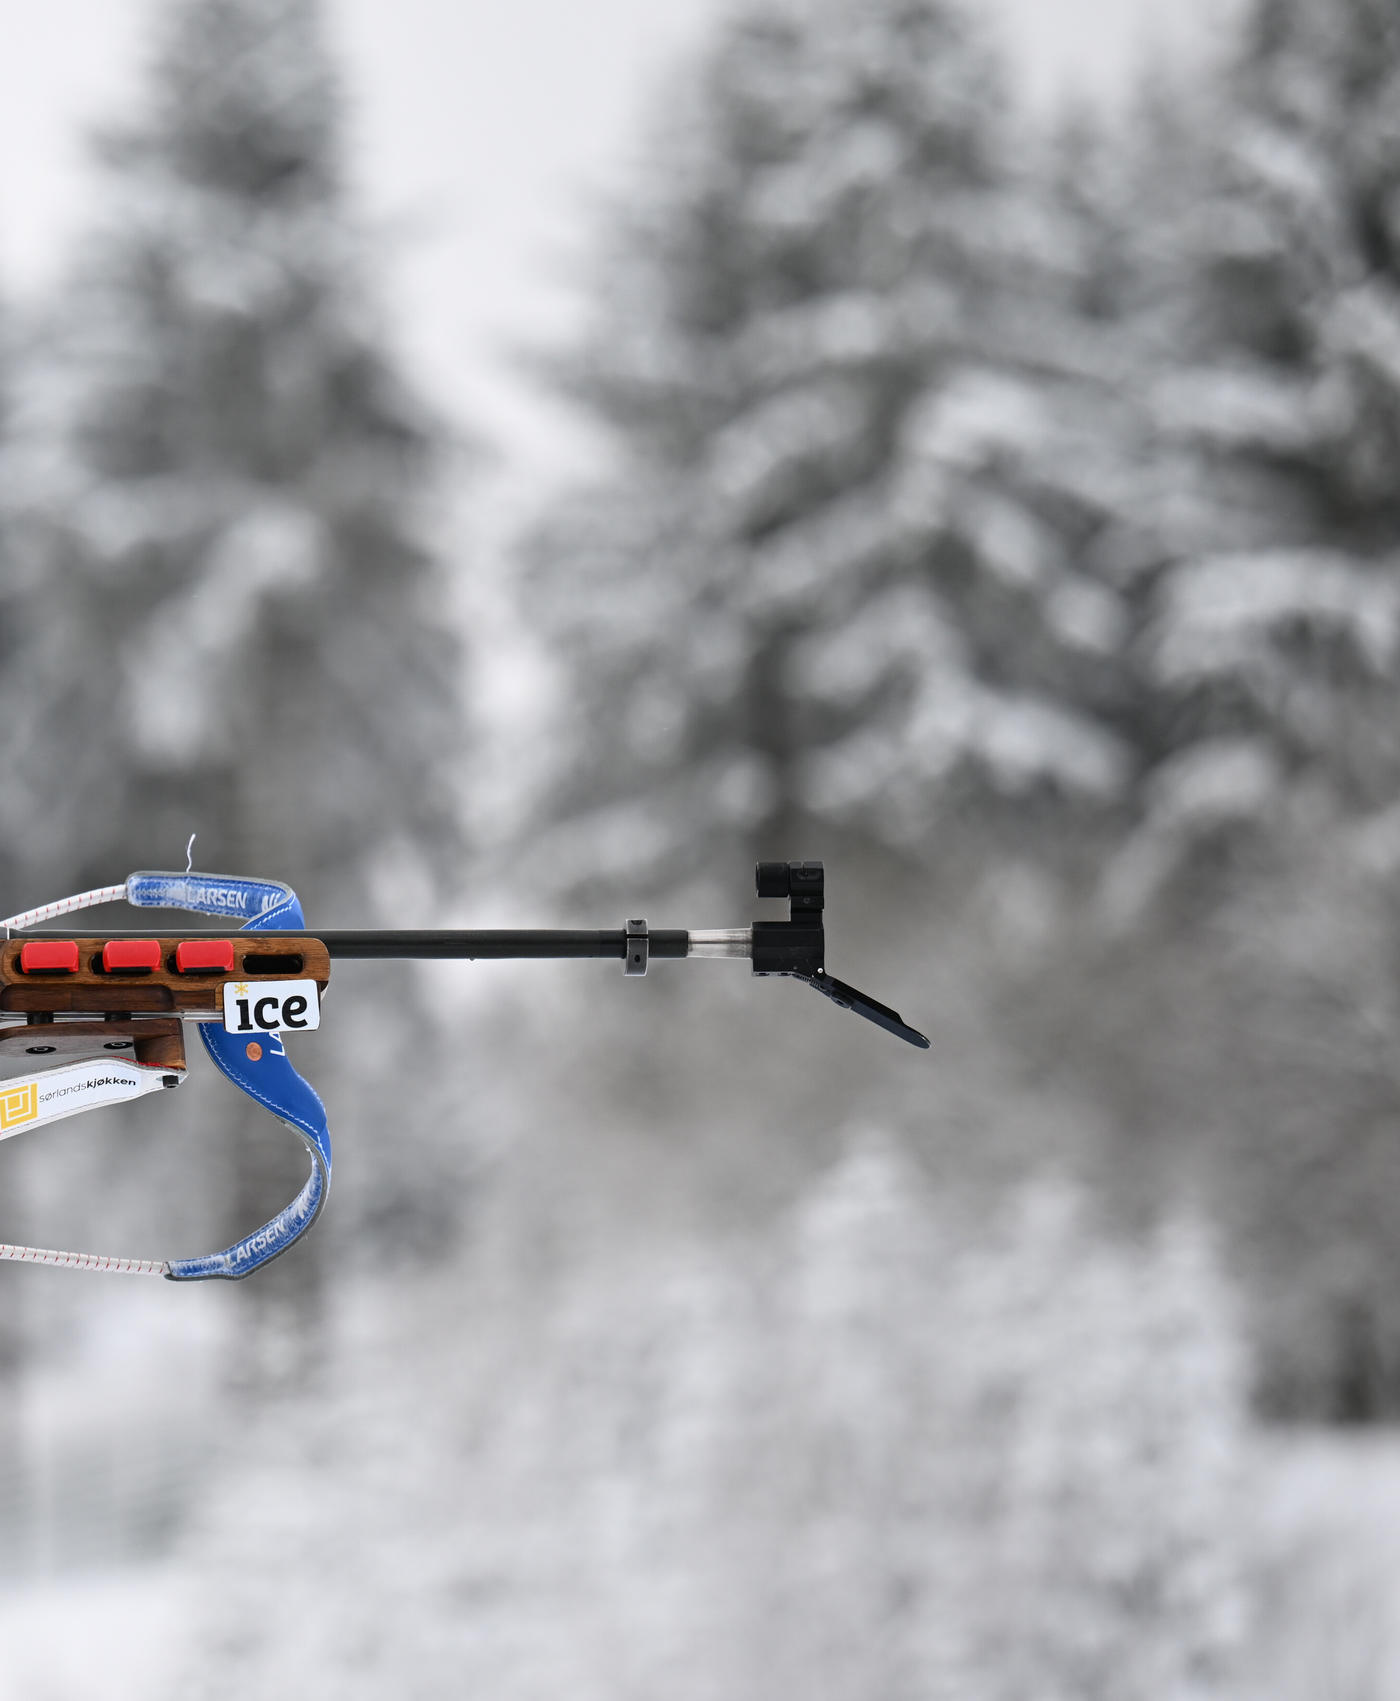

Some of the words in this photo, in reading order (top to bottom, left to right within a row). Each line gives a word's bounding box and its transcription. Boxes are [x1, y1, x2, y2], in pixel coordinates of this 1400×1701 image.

[188, 887, 247, 909] LARSEN
[235, 988, 309, 1031] ice
[38, 1076, 137, 1103] sørlandskjøkken
[225, 1217, 288, 1267] LARSEN
